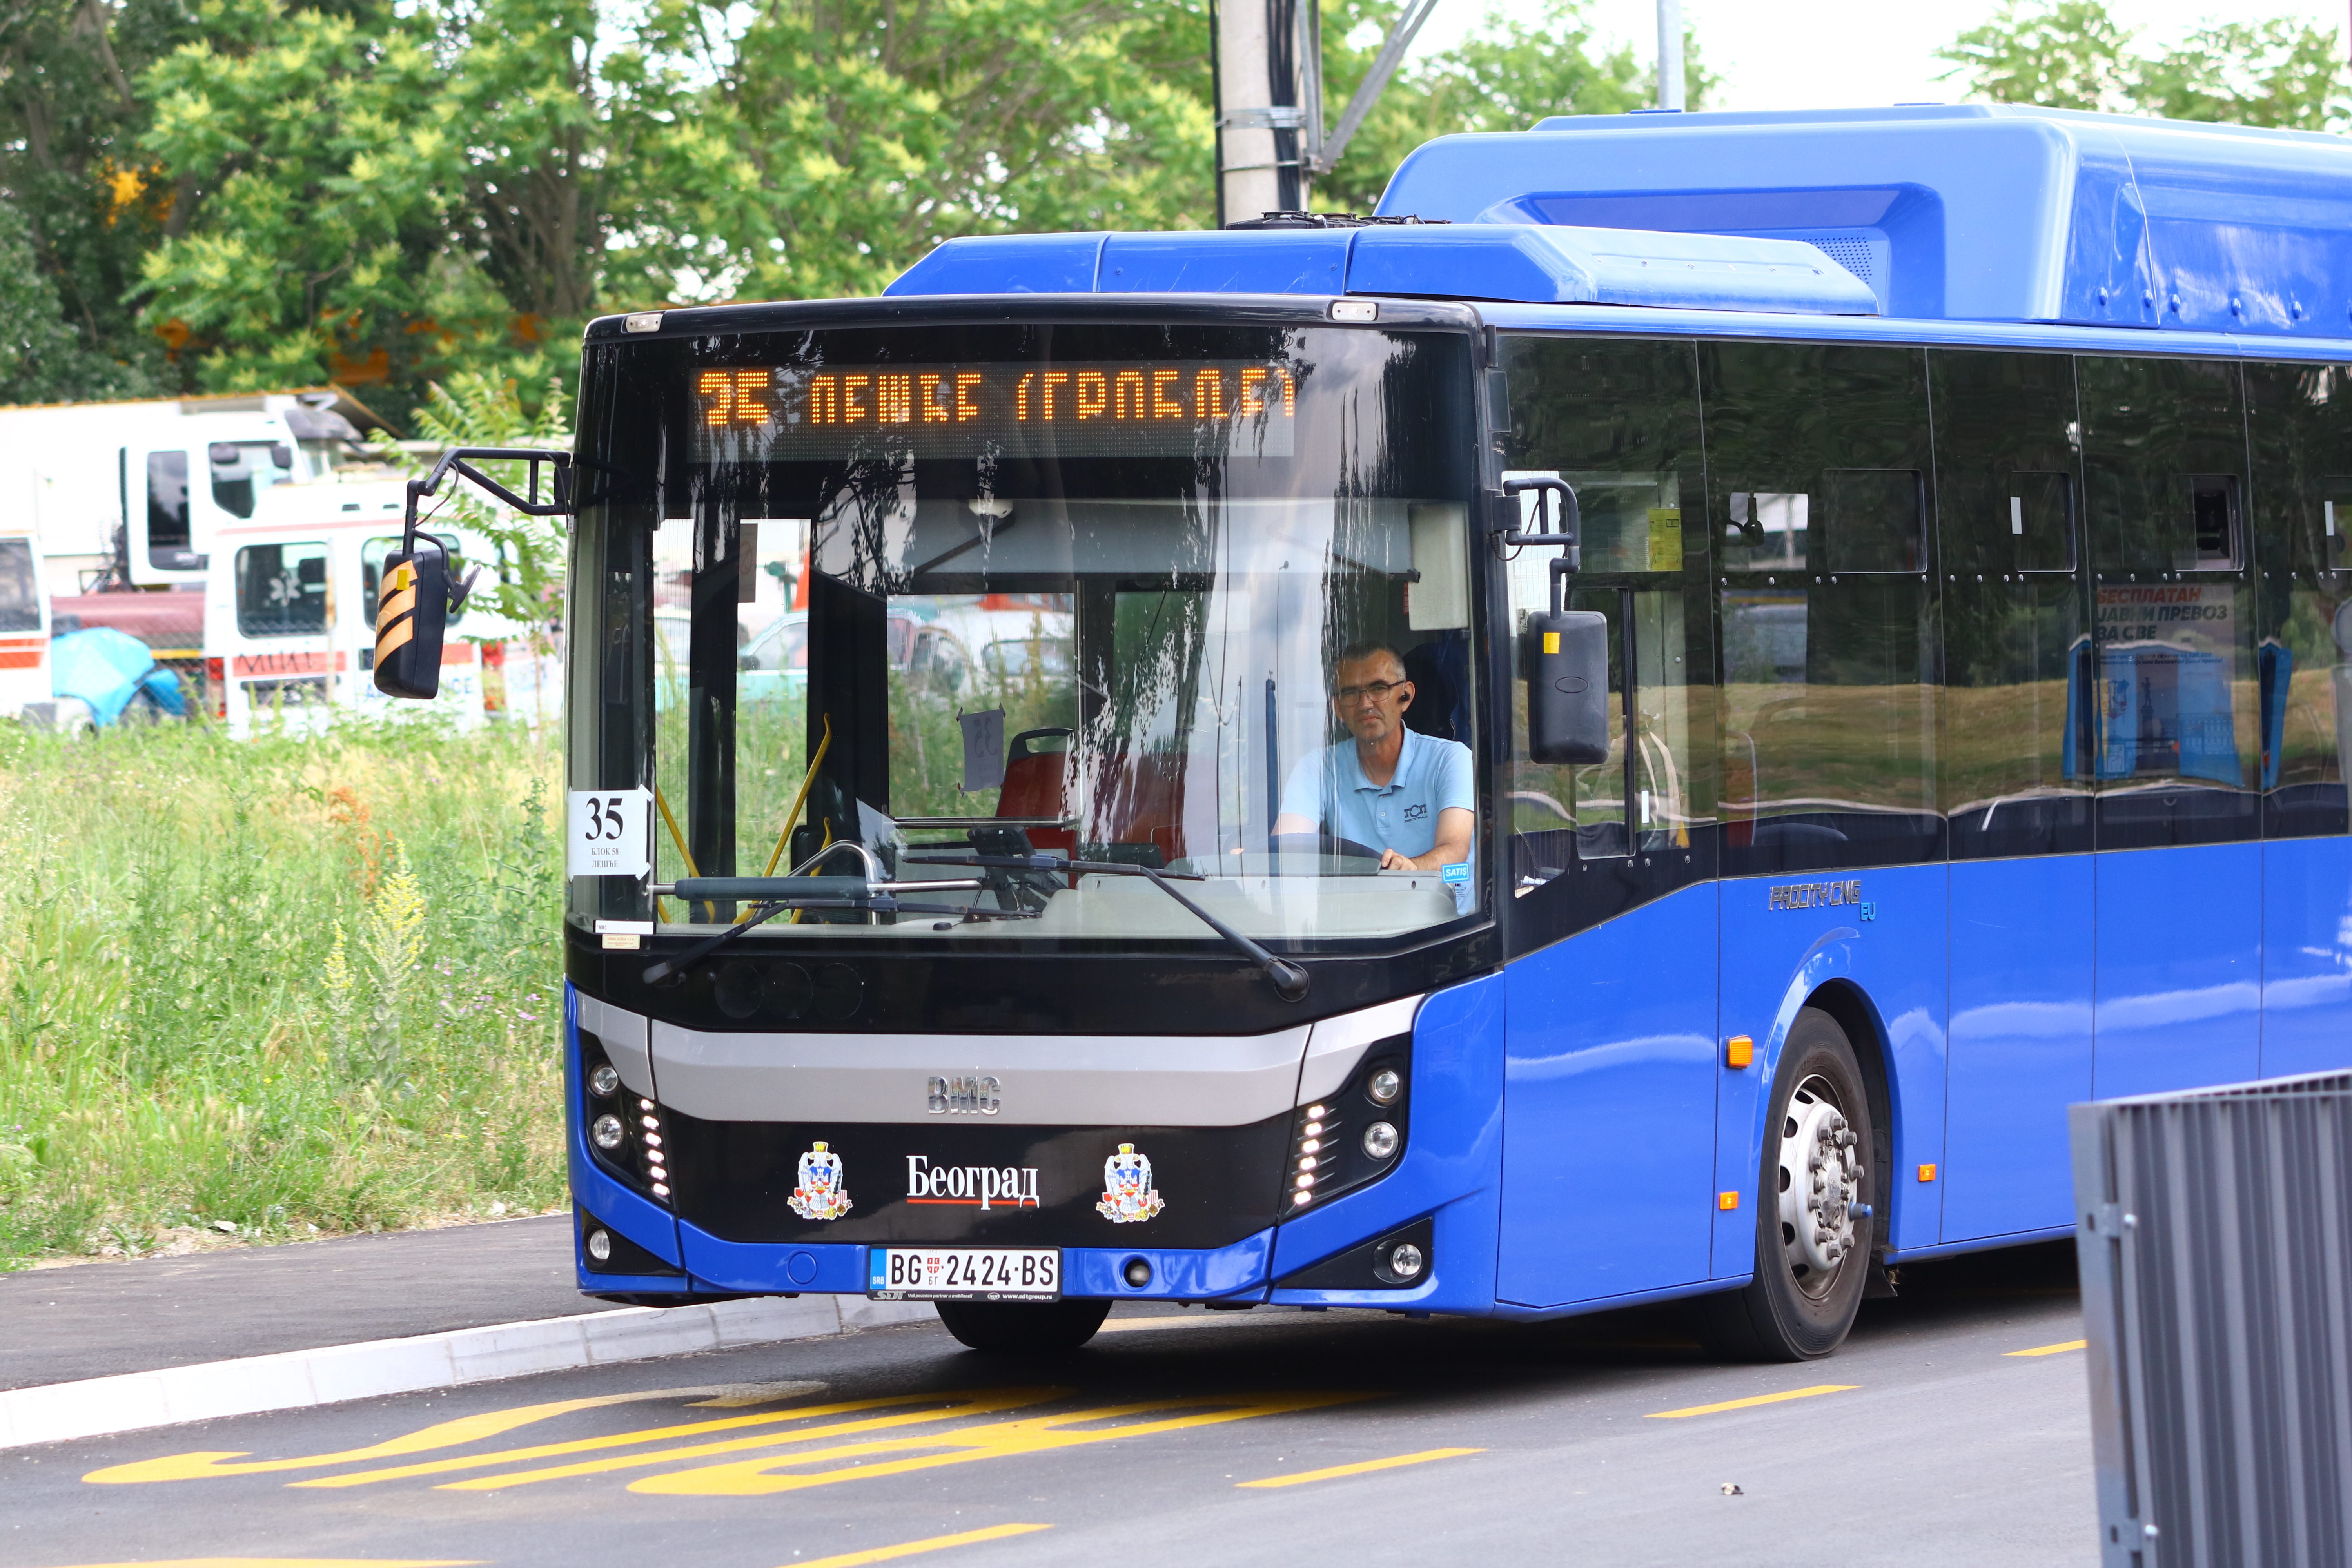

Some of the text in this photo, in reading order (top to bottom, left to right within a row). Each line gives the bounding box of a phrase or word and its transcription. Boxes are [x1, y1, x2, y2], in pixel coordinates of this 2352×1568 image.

[2097, 587, 2201, 604] БЕСПЛАТАН
[2097, 605, 2228, 622] ЈАВНИ ПРЕВОЗ
[2098, 625, 2157, 641] ЗА СВЕ
[586, 797, 623, 840] 35
[1445, 867, 1467, 877] SATIŞ
[1769, 880, 1861, 911] PROCITY CNG
[1860, 902, 1876, 920] EU
[928, 1076, 1001, 1115] BMC
[906, 1155, 1040, 1210] Београд
[891, 1254, 921, 1285] BG
[873, 1291, 906, 1300] SDT
